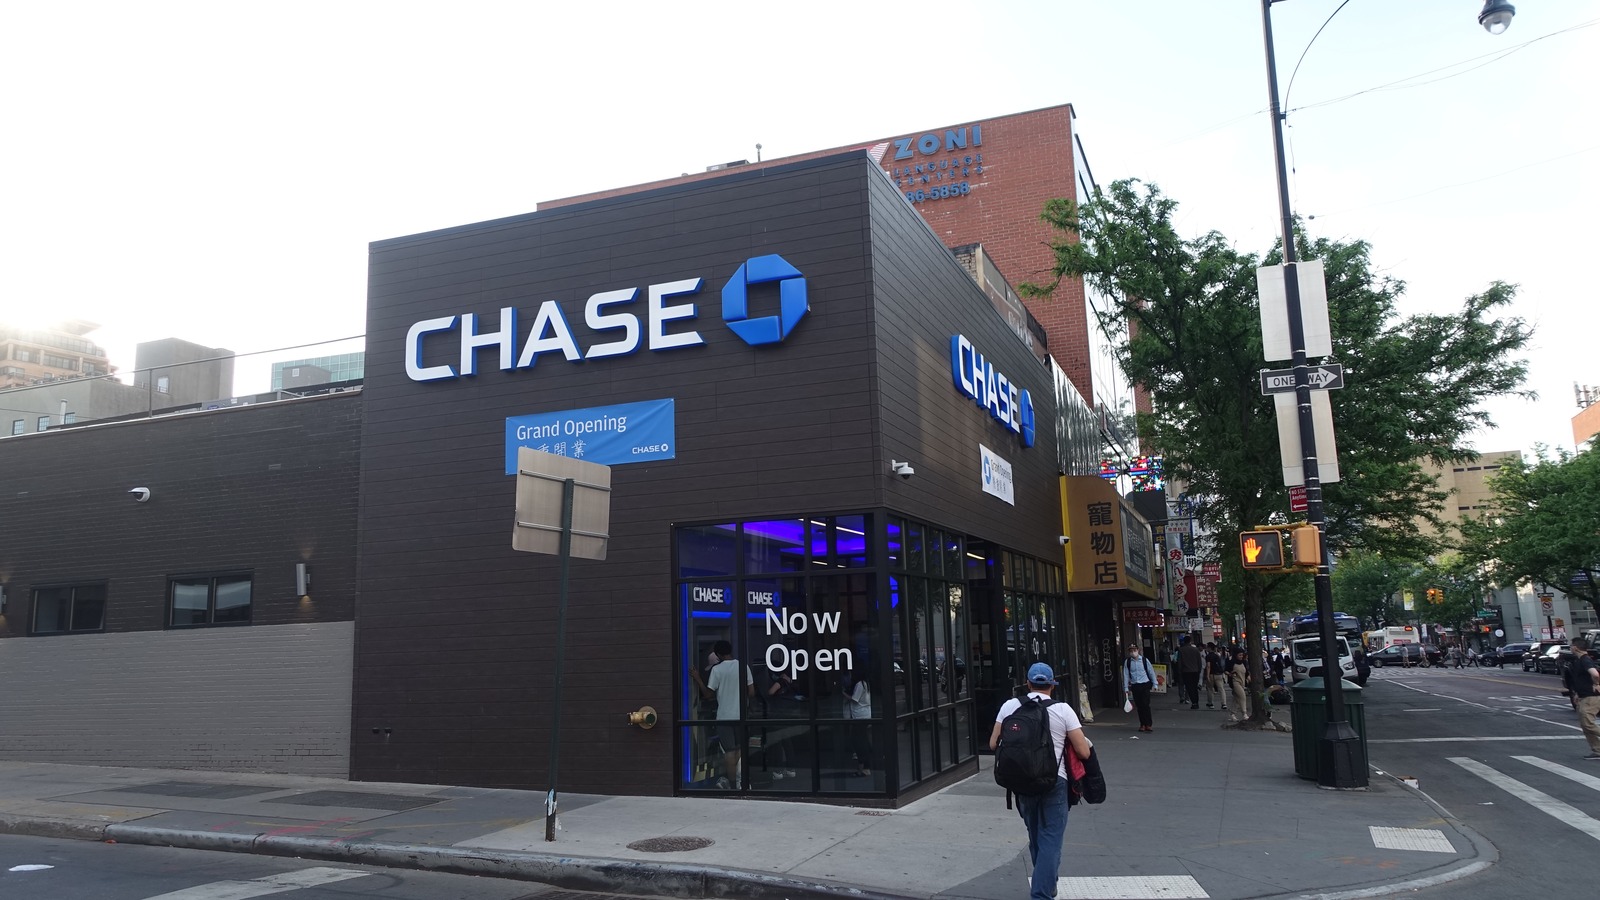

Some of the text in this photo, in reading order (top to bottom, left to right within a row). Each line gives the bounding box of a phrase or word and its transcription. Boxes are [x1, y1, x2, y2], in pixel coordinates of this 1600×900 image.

[894, 124, 983, 161] ZONI
[893, 153, 983, 177] LANGUAGE
[895, 165, 984, 188] CENTERS
[405, 277, 706, 382] CHASE
[951, 334, 1021, 434] CHASE
[1273, 375, 1296, 387] ONE
[517, 415, 628, 441] Grand Opening
[632, 445, 660, 455] CHASE
[1086, 501, 1118, 585] 寵物店
[693, 587, 724, 603] CHASE
[747, 591, 773, 605] CHASE
[765, 607, 841, 635] Now
[765, 643, 853, 680] Open
